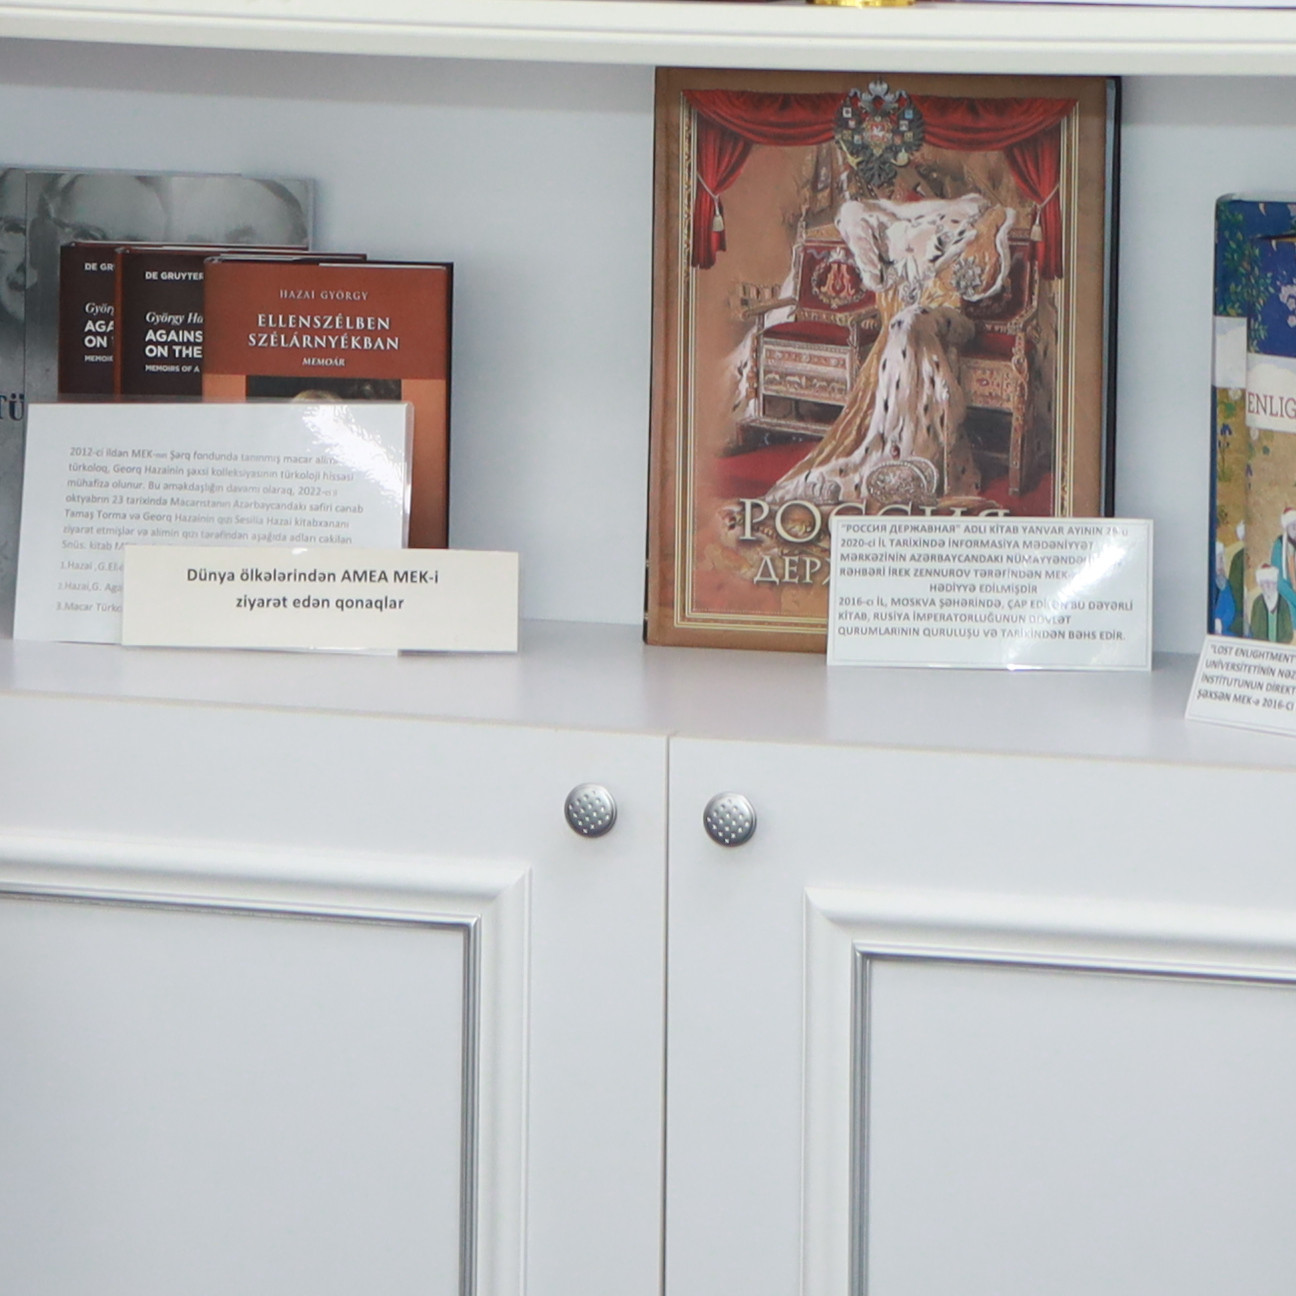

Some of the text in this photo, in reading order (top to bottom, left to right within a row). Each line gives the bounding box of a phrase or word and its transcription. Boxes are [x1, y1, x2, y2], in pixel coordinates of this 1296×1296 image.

[85, 262, 98, 271] DE
[145, 271, 159, 280] DE
[280, 289, 369, 301] HAZAI GYÖRGY
[145, 312, 185, 326] György
[257, 313, 391, 331] ELLENSZÉLBEN
[84, 335, 108, 348] ON
[145, 329, 204, 343] AGAINS
[248, 331, 400, 351] SZÉLÁRNYÉKBAN
[145, 345, 203, 359] ON THE
[302, 357, 346, 368] MEMOÁR
[181, 365, 193, 373] OF
[112, 495, 124, 504] 23
[963, 524, 987, 534] ADLI
[989, 523, 1019, 534] KİTAB
[1022, 525, 1065, 536] YANVAR
[1067, 526, 1103, 536] AYININ
[889, 537, 946, 549] TARİXİNDƏ
[840, 552, 907, 563] MƏRKƏZİNİN
[187, 567, 440, 585] Dünya ölkələrindən AMEA MEK-i
[913, 567, 971, 579] ZENNUROV
[235, 594, 405, 612] ziyarət edən qonaqlar
[890, 597, 937, 608] MOSKVA
[873, 610, 910, 622] RUSİYA
[922, 627, 980, 640] QURULUŞU
[1068, 630, 1097, 641] BƏHS
